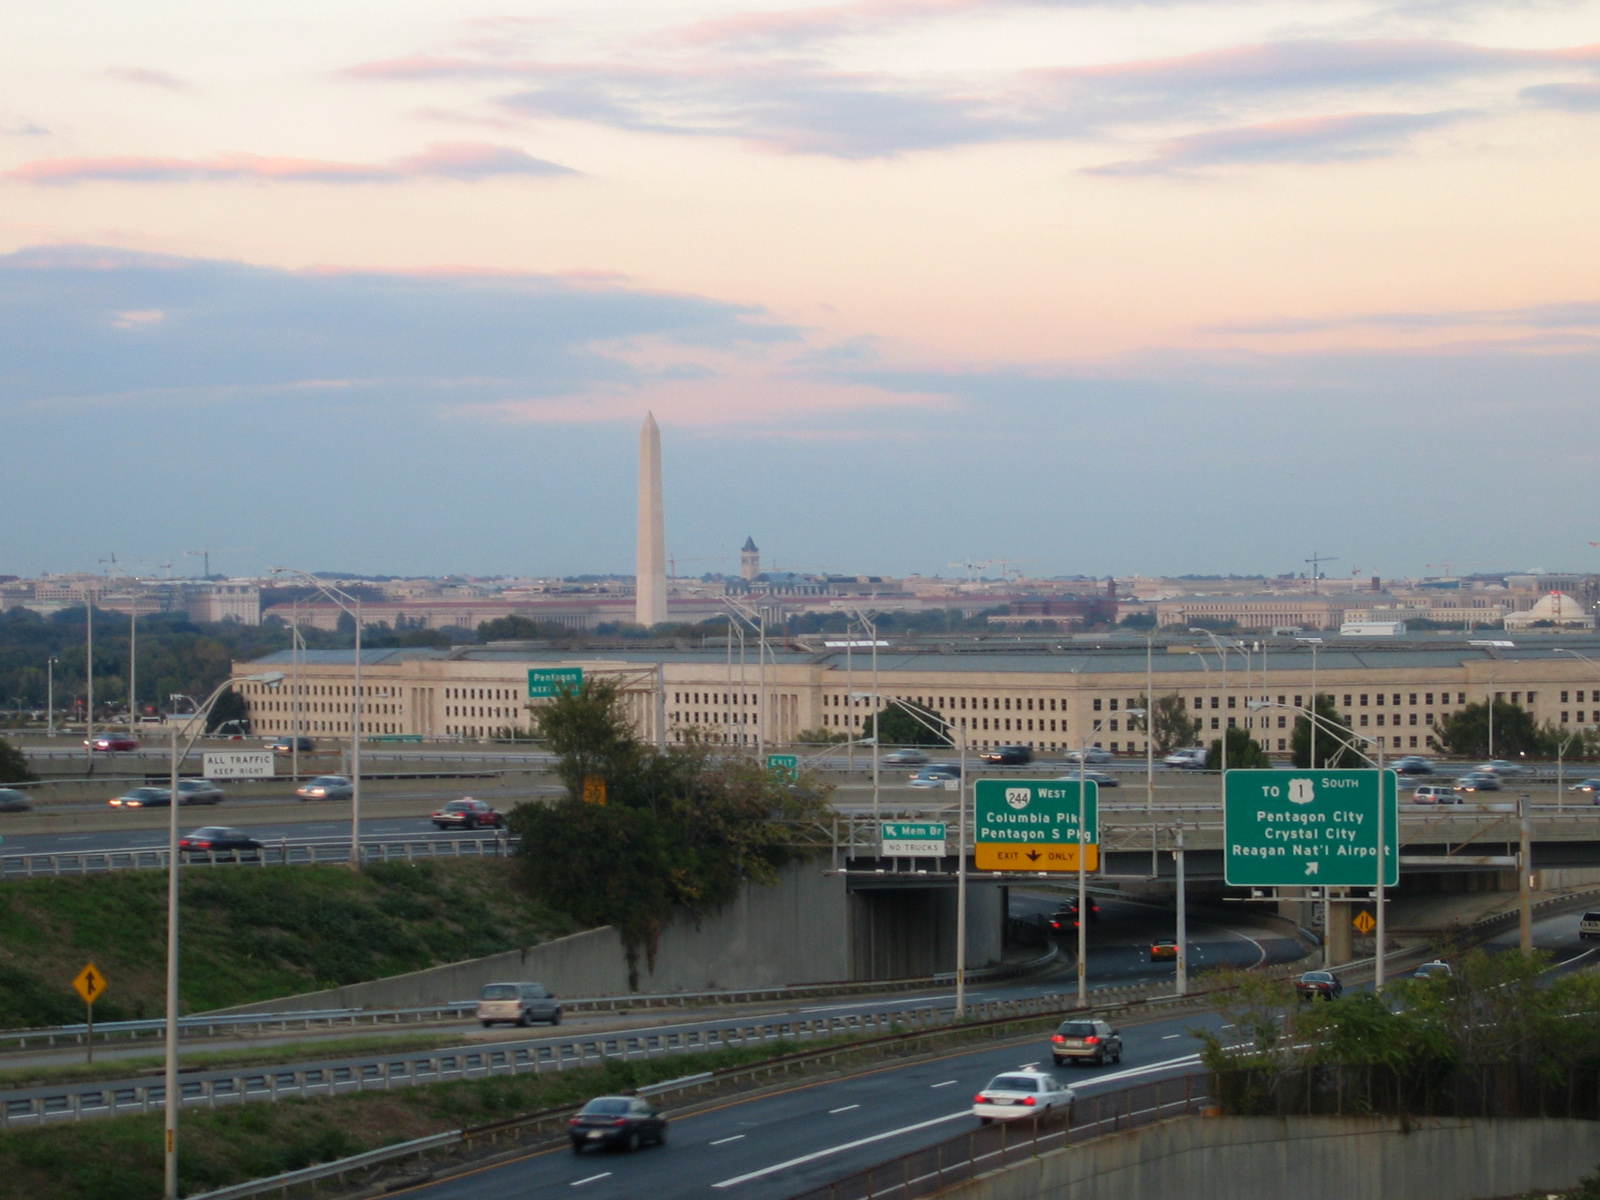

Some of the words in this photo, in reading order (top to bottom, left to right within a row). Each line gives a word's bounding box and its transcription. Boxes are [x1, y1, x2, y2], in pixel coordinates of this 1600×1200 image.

[533, 673, 577, 683] Pentagon
[230, 756, 270, 764] TRAFFIC
[1262, 786, 1280, 797] TO
[1298, 784, 1304, 798] 1
[1009, 792, 1029, 804] 244
[986, 812, 1051, 823] Columbia
[1257, 811, 1326, 825] Pentagon
[1333, 811, 1364, 825] City
[902, 827, 925, 835] Mem
[930, 827, 942, 835] Br
[981, 828, 1045, 842] Pentagon
[1051, 829, 1060, 839] S
[1265, 828, 1318, 842] Crystal
[1325, 828, 1357, 842] City
[997, 852, 1019, 860] EXIT
[1048, 852, 1075, 861] ONLY
[1232, 845, 1286, 859] Reagan
[1336, 845, 1390, 858] Airpot
